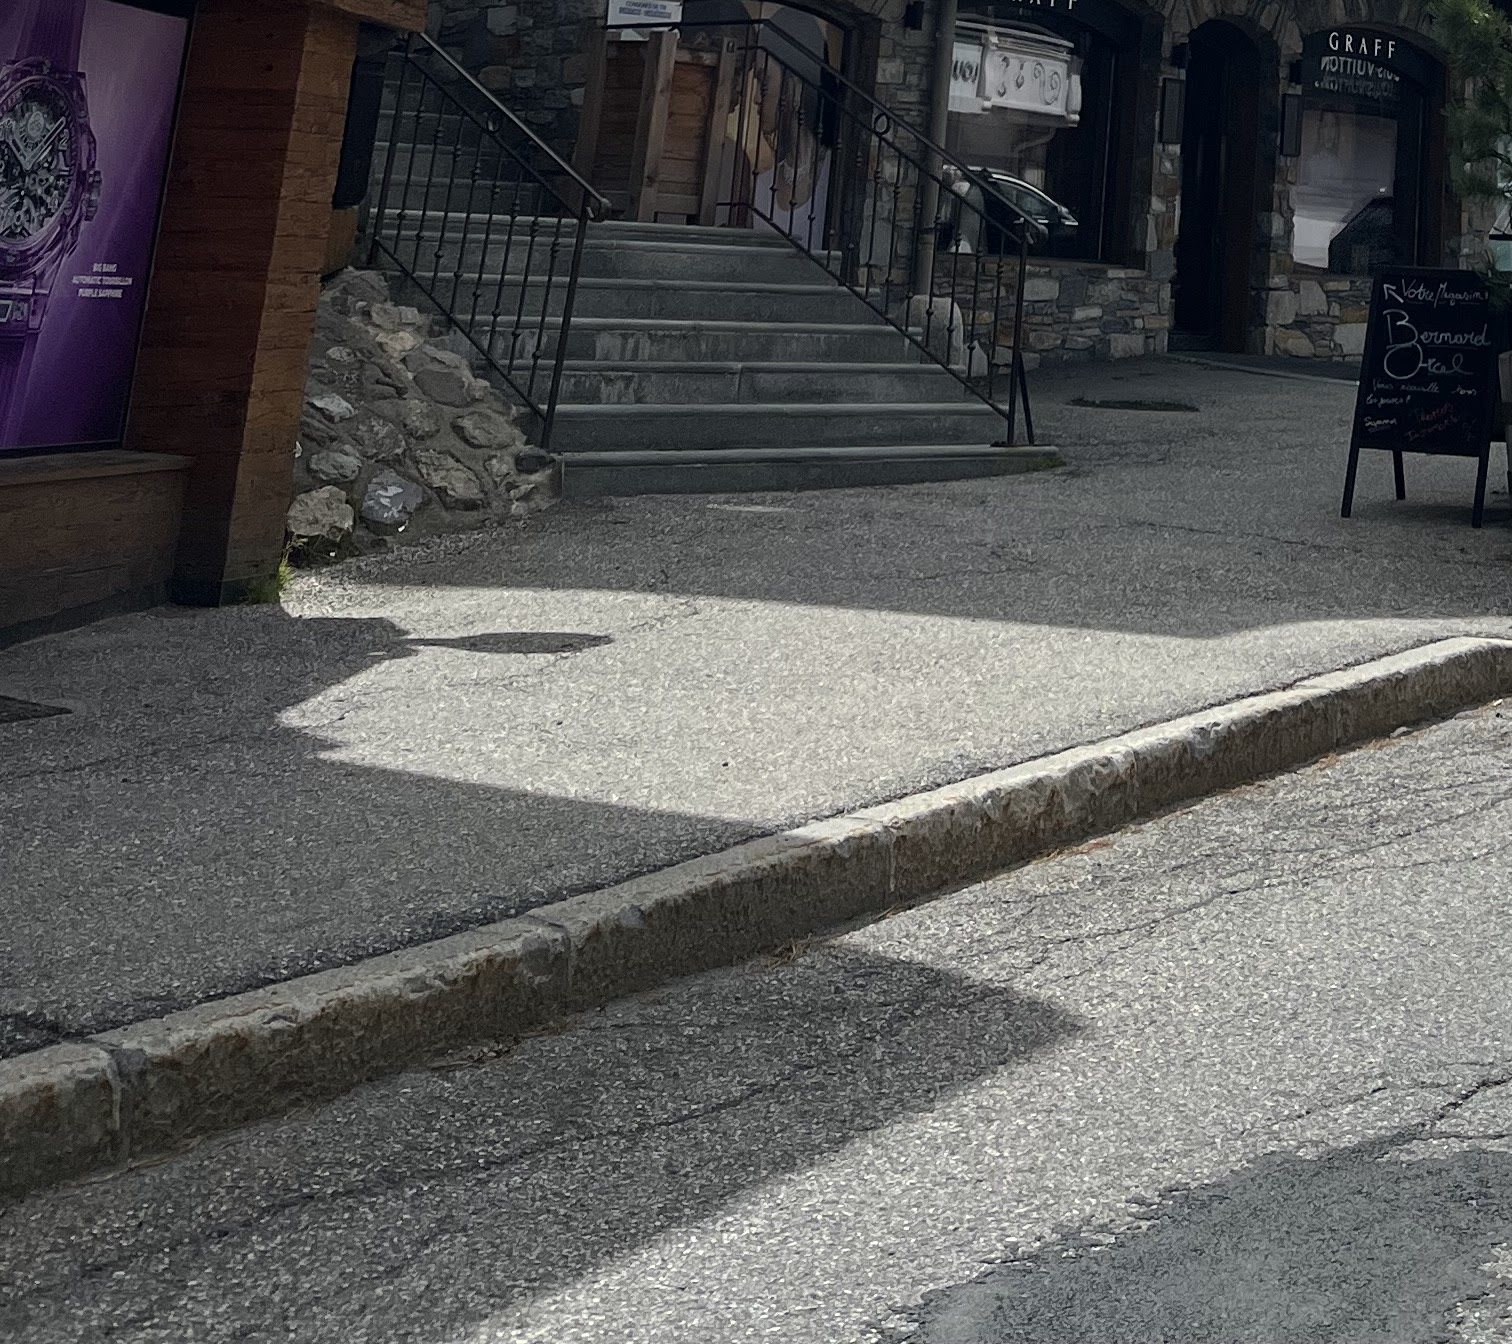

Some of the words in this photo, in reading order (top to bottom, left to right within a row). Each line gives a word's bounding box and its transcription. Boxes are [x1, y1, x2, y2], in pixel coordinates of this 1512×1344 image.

[1329, 32, 1396, 59] GRAFF
[1402, 278, 1434, 301] Votre
[1383, 309, 1491, 349] Bernard
[1384, 342, 1474, 379] Orcel
